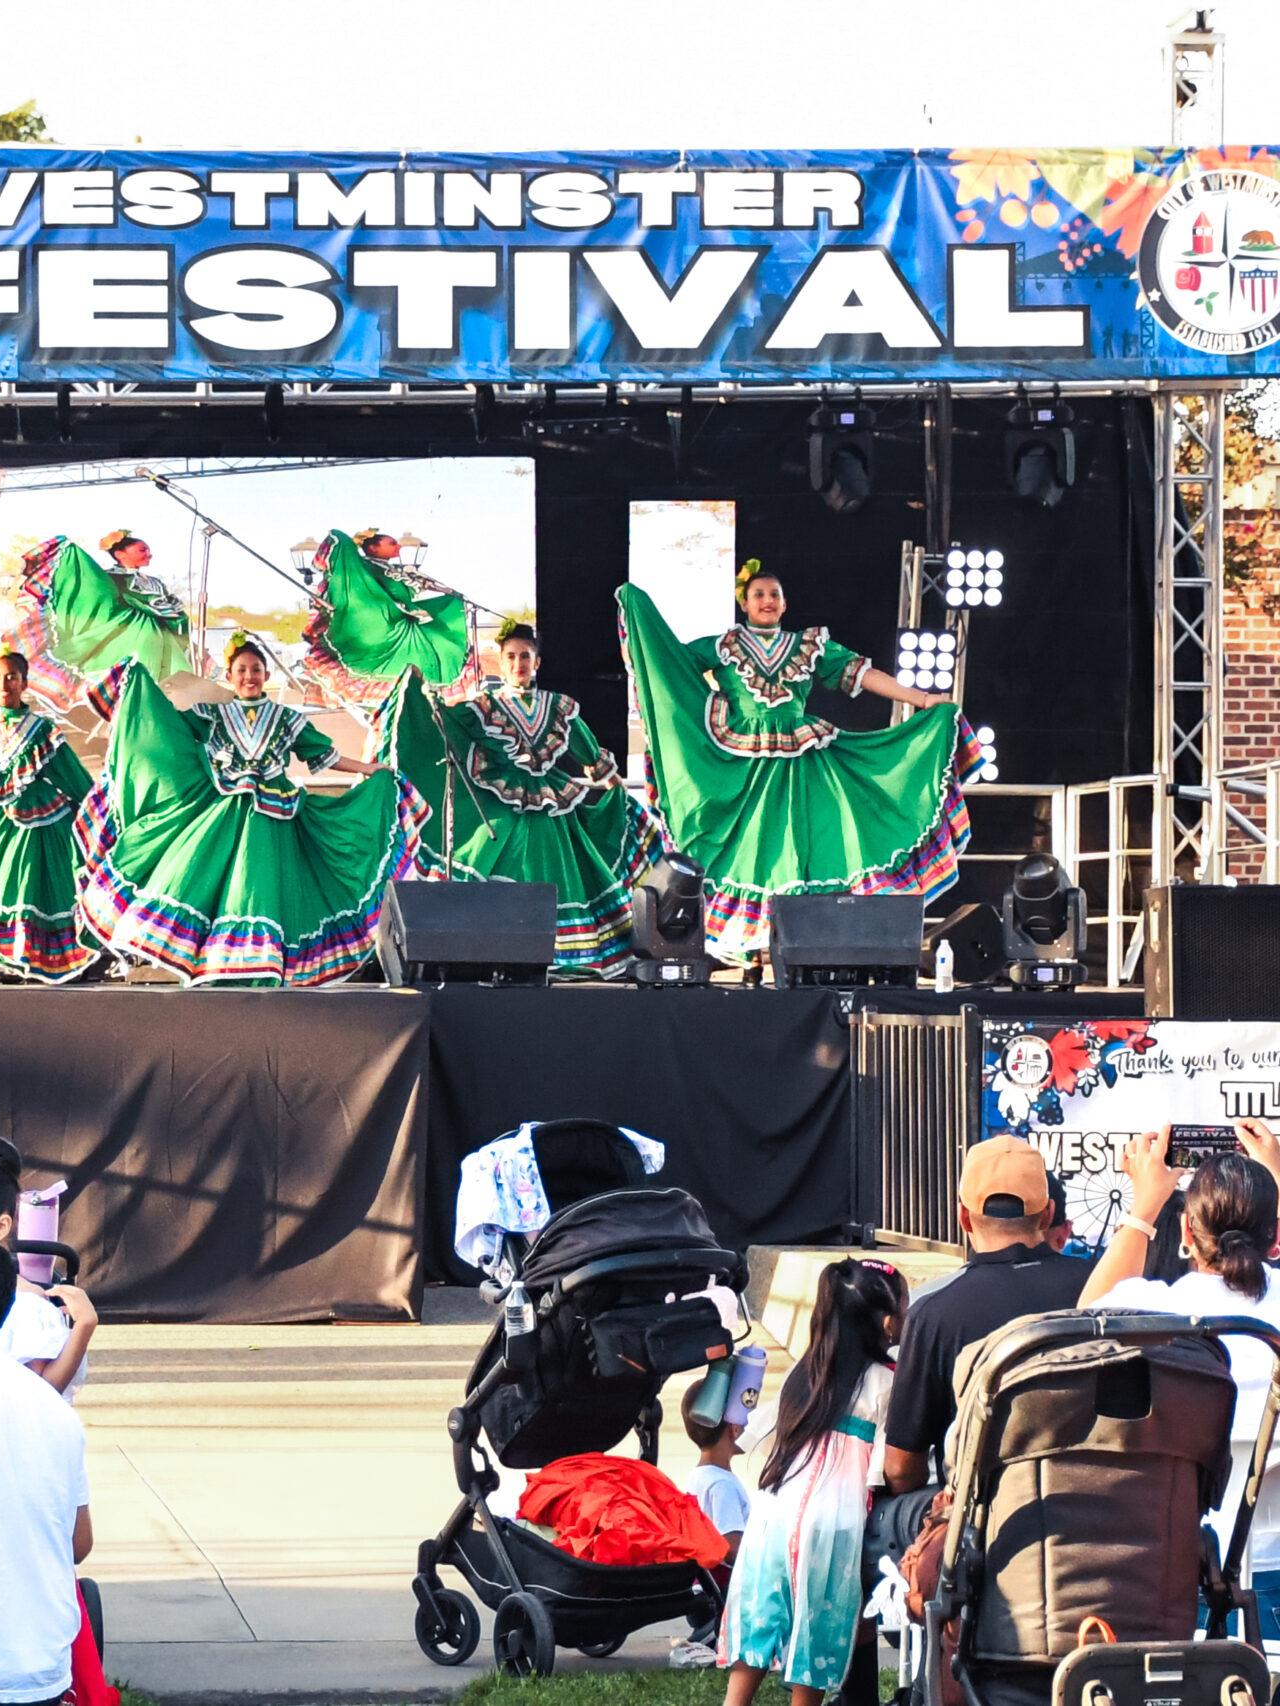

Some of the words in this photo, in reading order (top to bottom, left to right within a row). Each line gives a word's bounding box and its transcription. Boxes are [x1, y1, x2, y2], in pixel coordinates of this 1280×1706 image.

[1173, 319, 1247, 351] ESTABLISHED
[1248, 321, 1277, 347] 1951
[1106, 1047, 1170, 1074] Thank
[1180, 1053, 1212, 1078] you
[1222, 1047, 1241, 1066] to
[1028, 1132, 1141, 1173] WEST
